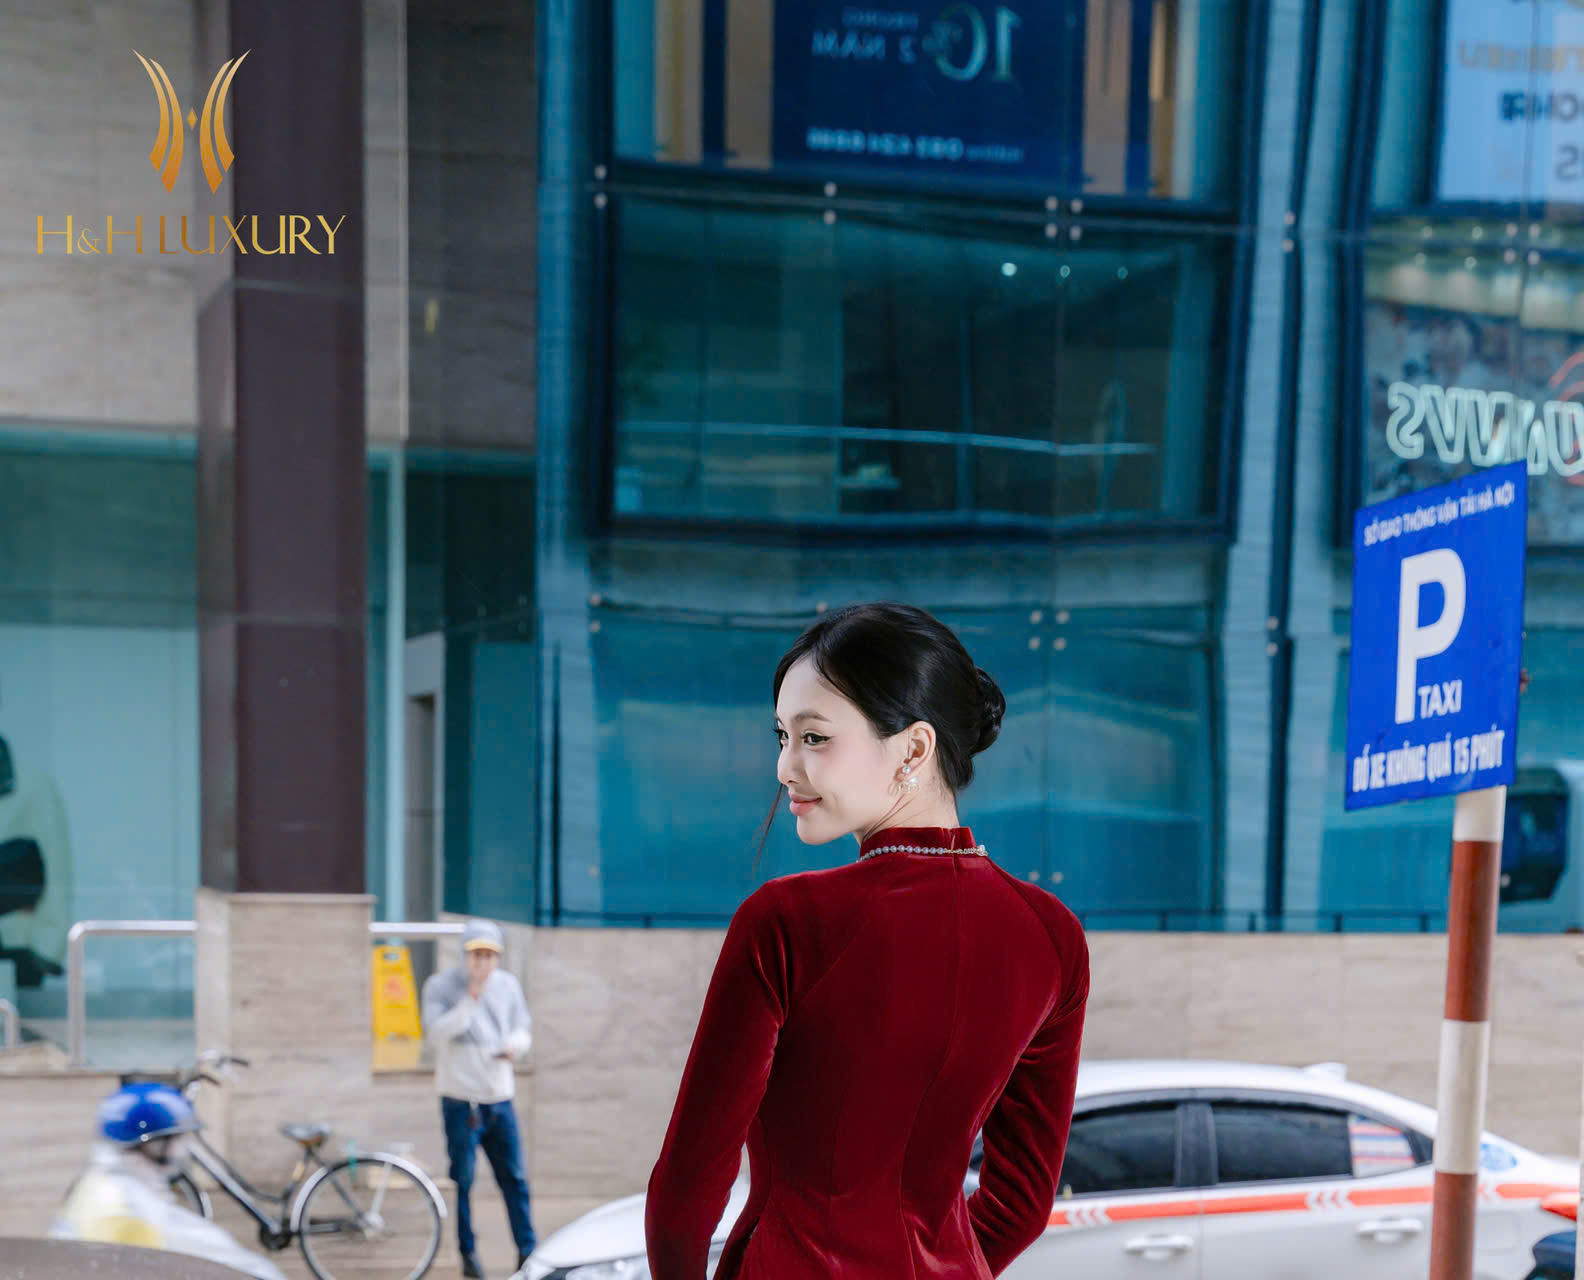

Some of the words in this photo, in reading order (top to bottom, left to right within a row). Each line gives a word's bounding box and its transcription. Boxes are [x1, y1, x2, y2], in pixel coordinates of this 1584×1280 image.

[1395, 547, 1467, 725] P
[1417, 679, 1463, 720] TAXI
[1370, 752, 1386, 790] XE
[1453, 736, 1470, 775] 15
